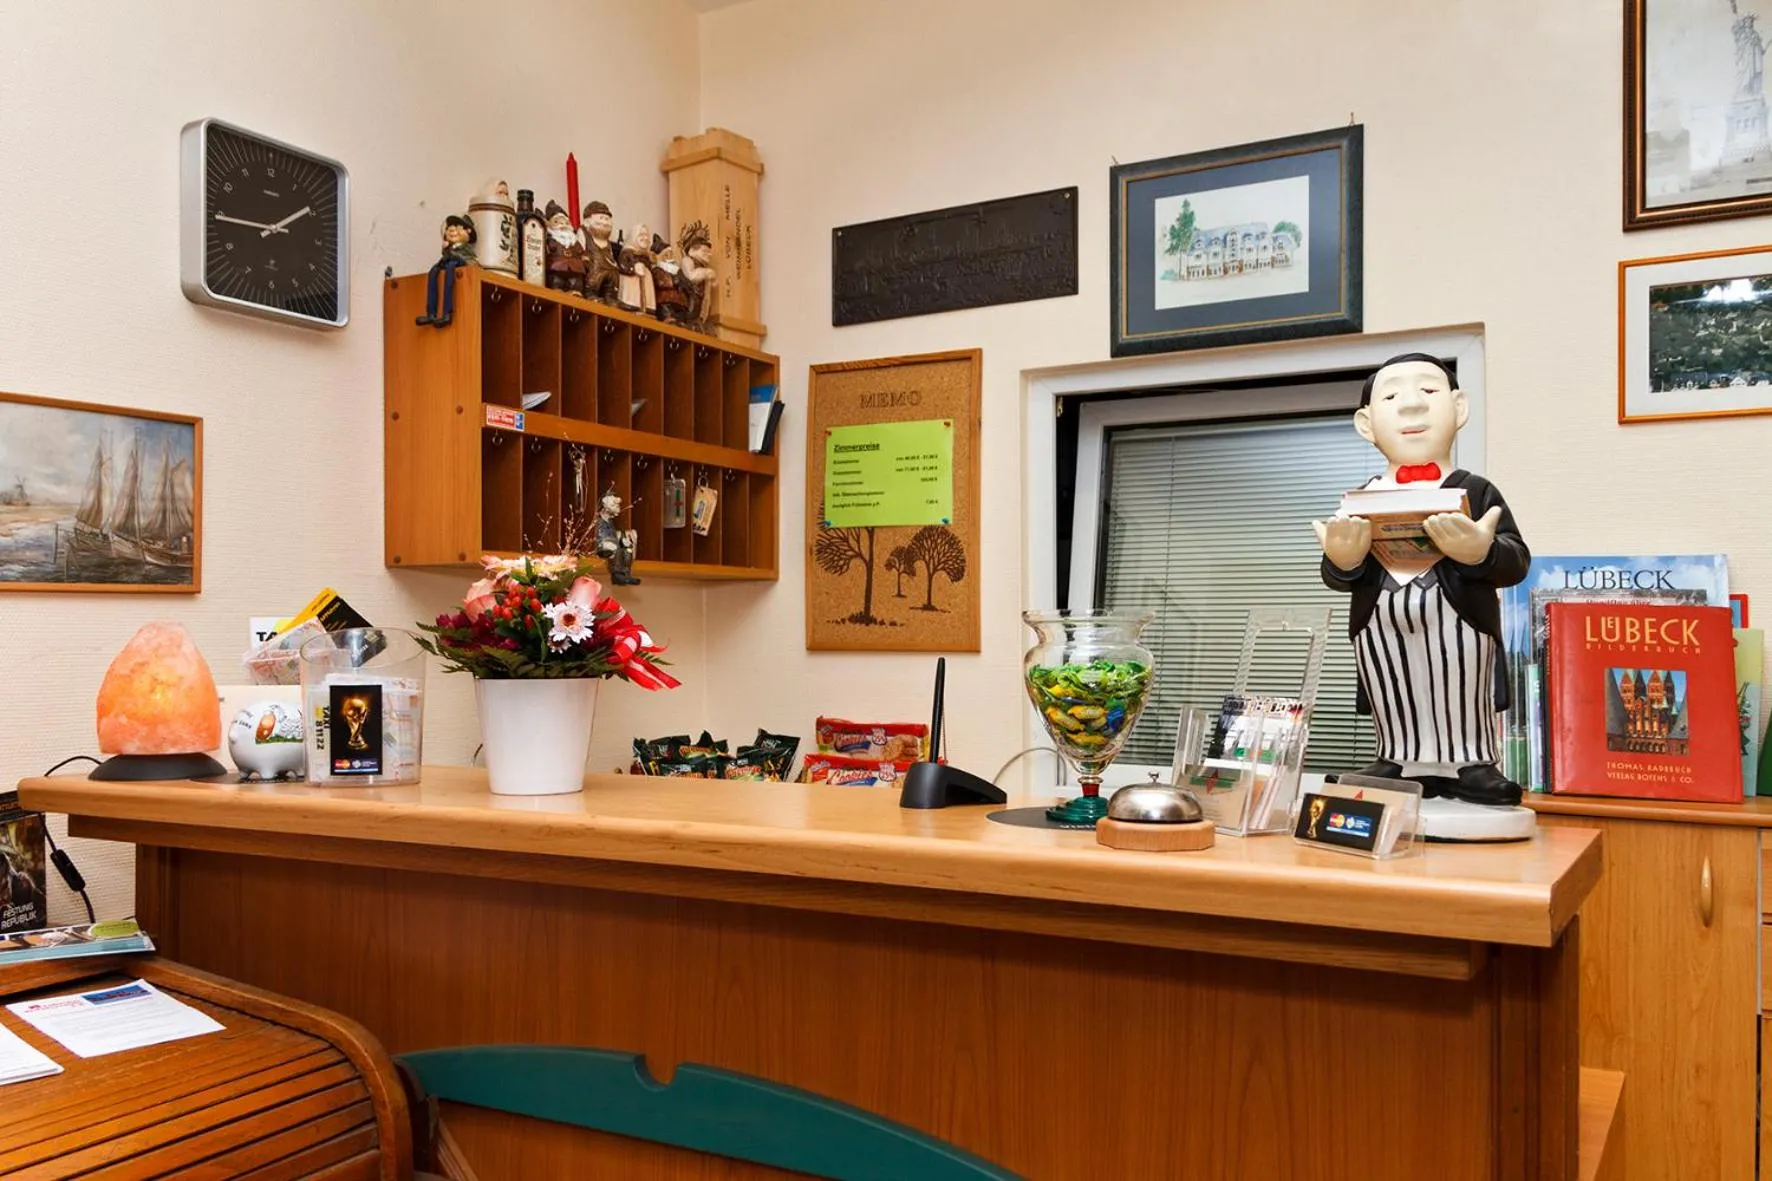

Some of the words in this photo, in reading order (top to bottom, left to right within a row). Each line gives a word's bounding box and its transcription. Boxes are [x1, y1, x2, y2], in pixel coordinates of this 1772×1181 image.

[267, 168, 276, 178] 12
[223, 182, 233, 193] 10
[225, 242, 234, 251] 8
[860, 390, 922, 409] MEMO
[834, 443, 880, 453] Zimmerpreise
[1564, 566, 1675, 590] LÜBECK
[1585, 643, 1701, 654] BILDERBUCH
[315, 720, 325, 750] 81122
[1606, 761, 1643, 771] THOMAS
[1606, 772, 1635, 780] VERLAG
[1679, 776, 1694, 784] CO.
[1, 912, 37, 929] REPUBLIK
